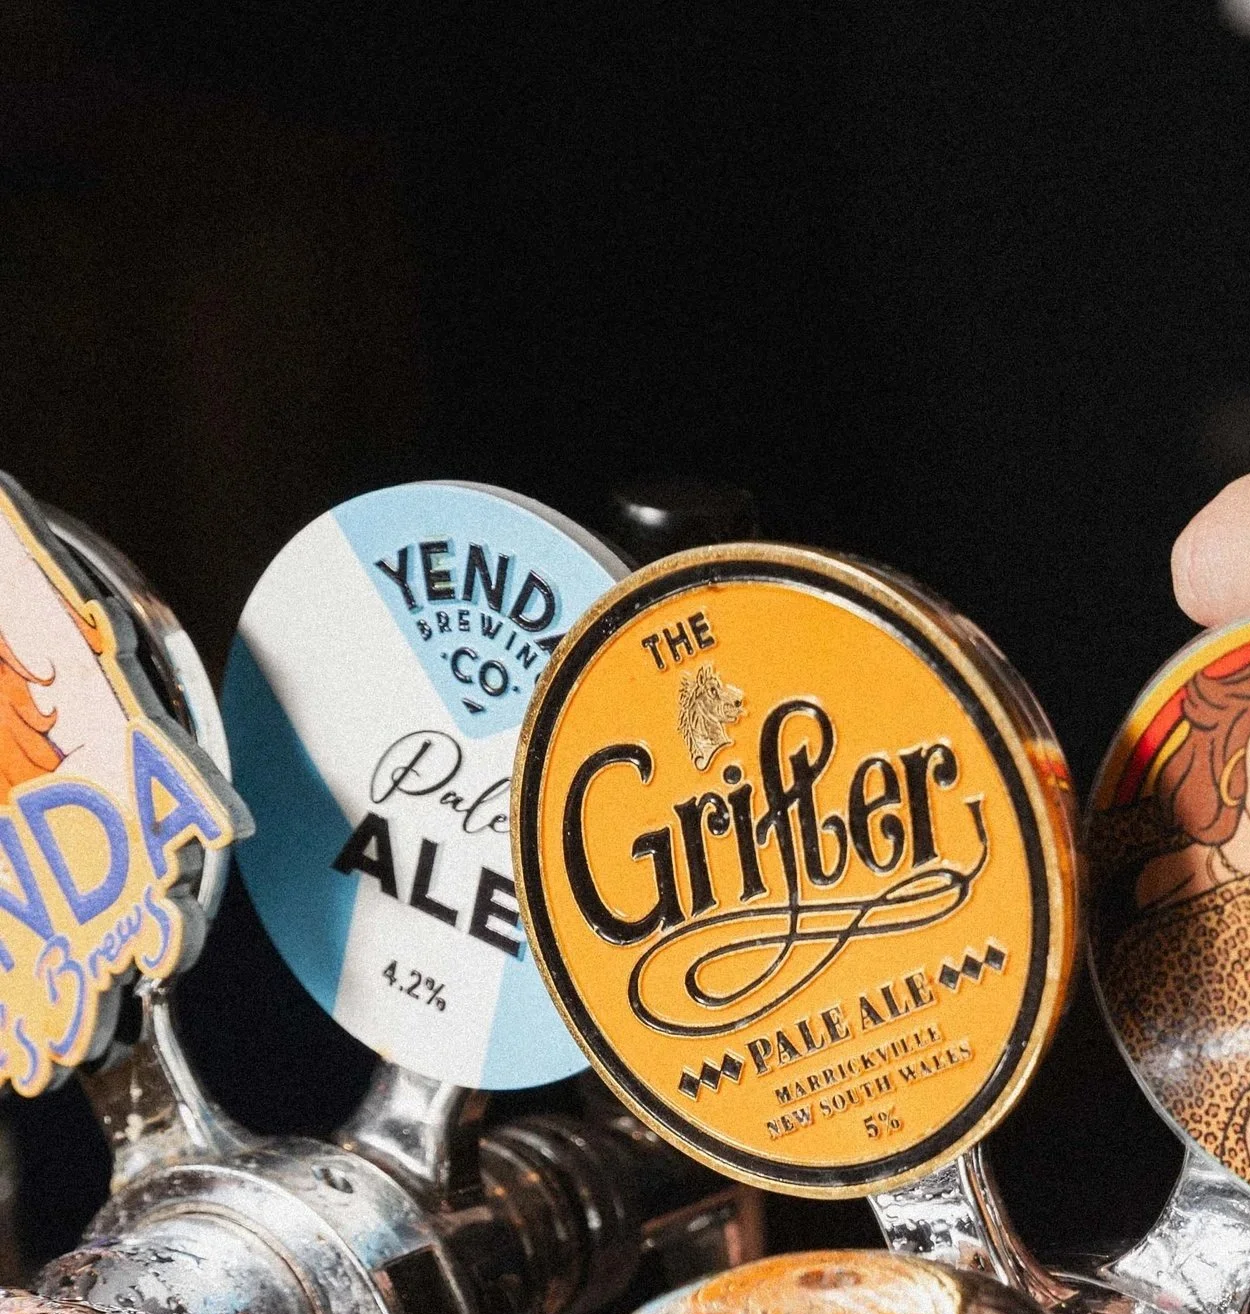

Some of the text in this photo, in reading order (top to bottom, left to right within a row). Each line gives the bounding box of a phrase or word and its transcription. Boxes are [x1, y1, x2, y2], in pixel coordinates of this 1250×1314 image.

[416, 609, 542, 685] BREWIN
[641, 611, 716, 671] THE
[562, 700, 986, 948] Grifter
[331, 811, 526, 959] ALE
[36, 885, 172, 1057] Brews
[382, 958, 448, 1013] 4.2%
[745, 969, 937, 1076] PALE ALE
[774, 1023, 943, 1106] MARRICKVILLE
[766, 1040, 973, 1141] NEW SOUTH WALES
[863, 1105, 902, 1139] 5%
